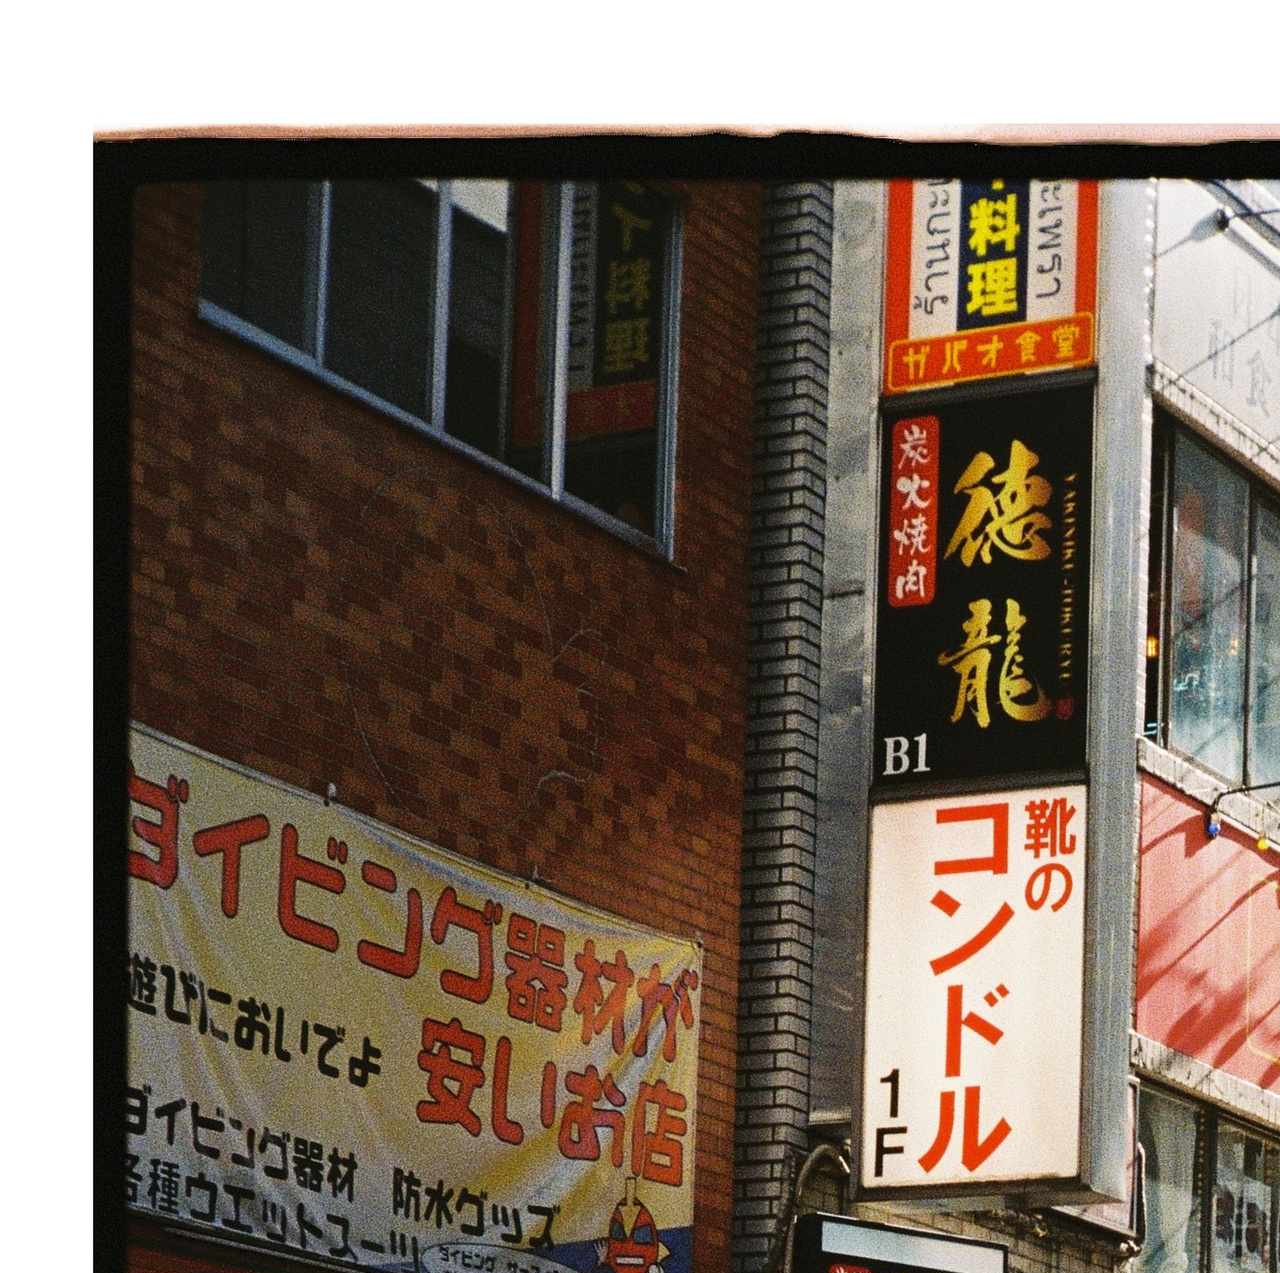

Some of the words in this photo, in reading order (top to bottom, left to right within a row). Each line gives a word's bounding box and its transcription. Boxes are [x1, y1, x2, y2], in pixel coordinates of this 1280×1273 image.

[966, 181, 1021, 317] 料理
[894, 424, 931, 599] 炭火焼肉
[883, 732, 931, 776] B1
[1024, 797, 1077, 913] 靴の
[127, 951, 383, 1089] 遊びにおいでよ
[917, 801, 1016, 1174] コンドル
[415, 1016, 689, 1189] 安いお店
[874, 1067, 908, 1178] 1F
